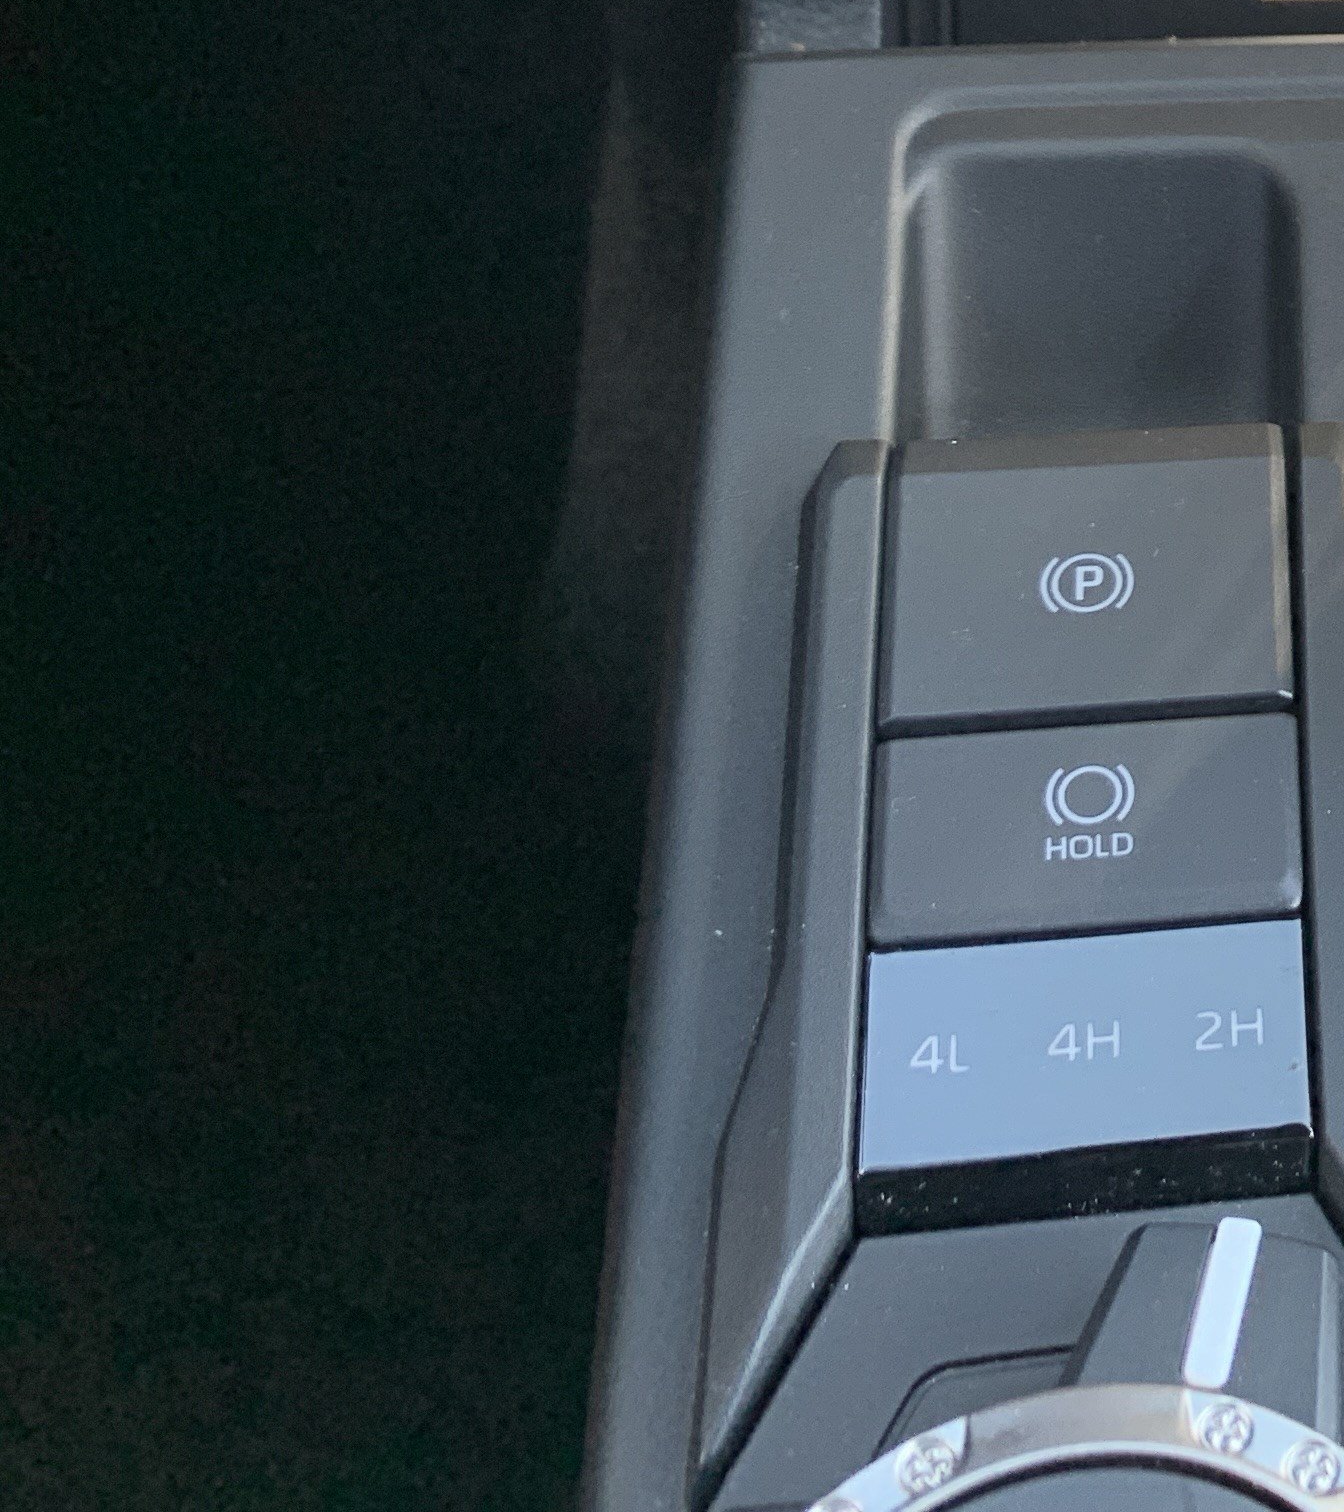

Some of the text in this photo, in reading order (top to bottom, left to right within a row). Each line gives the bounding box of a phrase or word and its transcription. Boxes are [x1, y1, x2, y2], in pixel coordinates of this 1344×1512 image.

[1073, 563, 1105, 602] P
[1044, 830, 1135, 862] HOLD
[909, 1007, 1265, 1076] 4L 4H 2H
